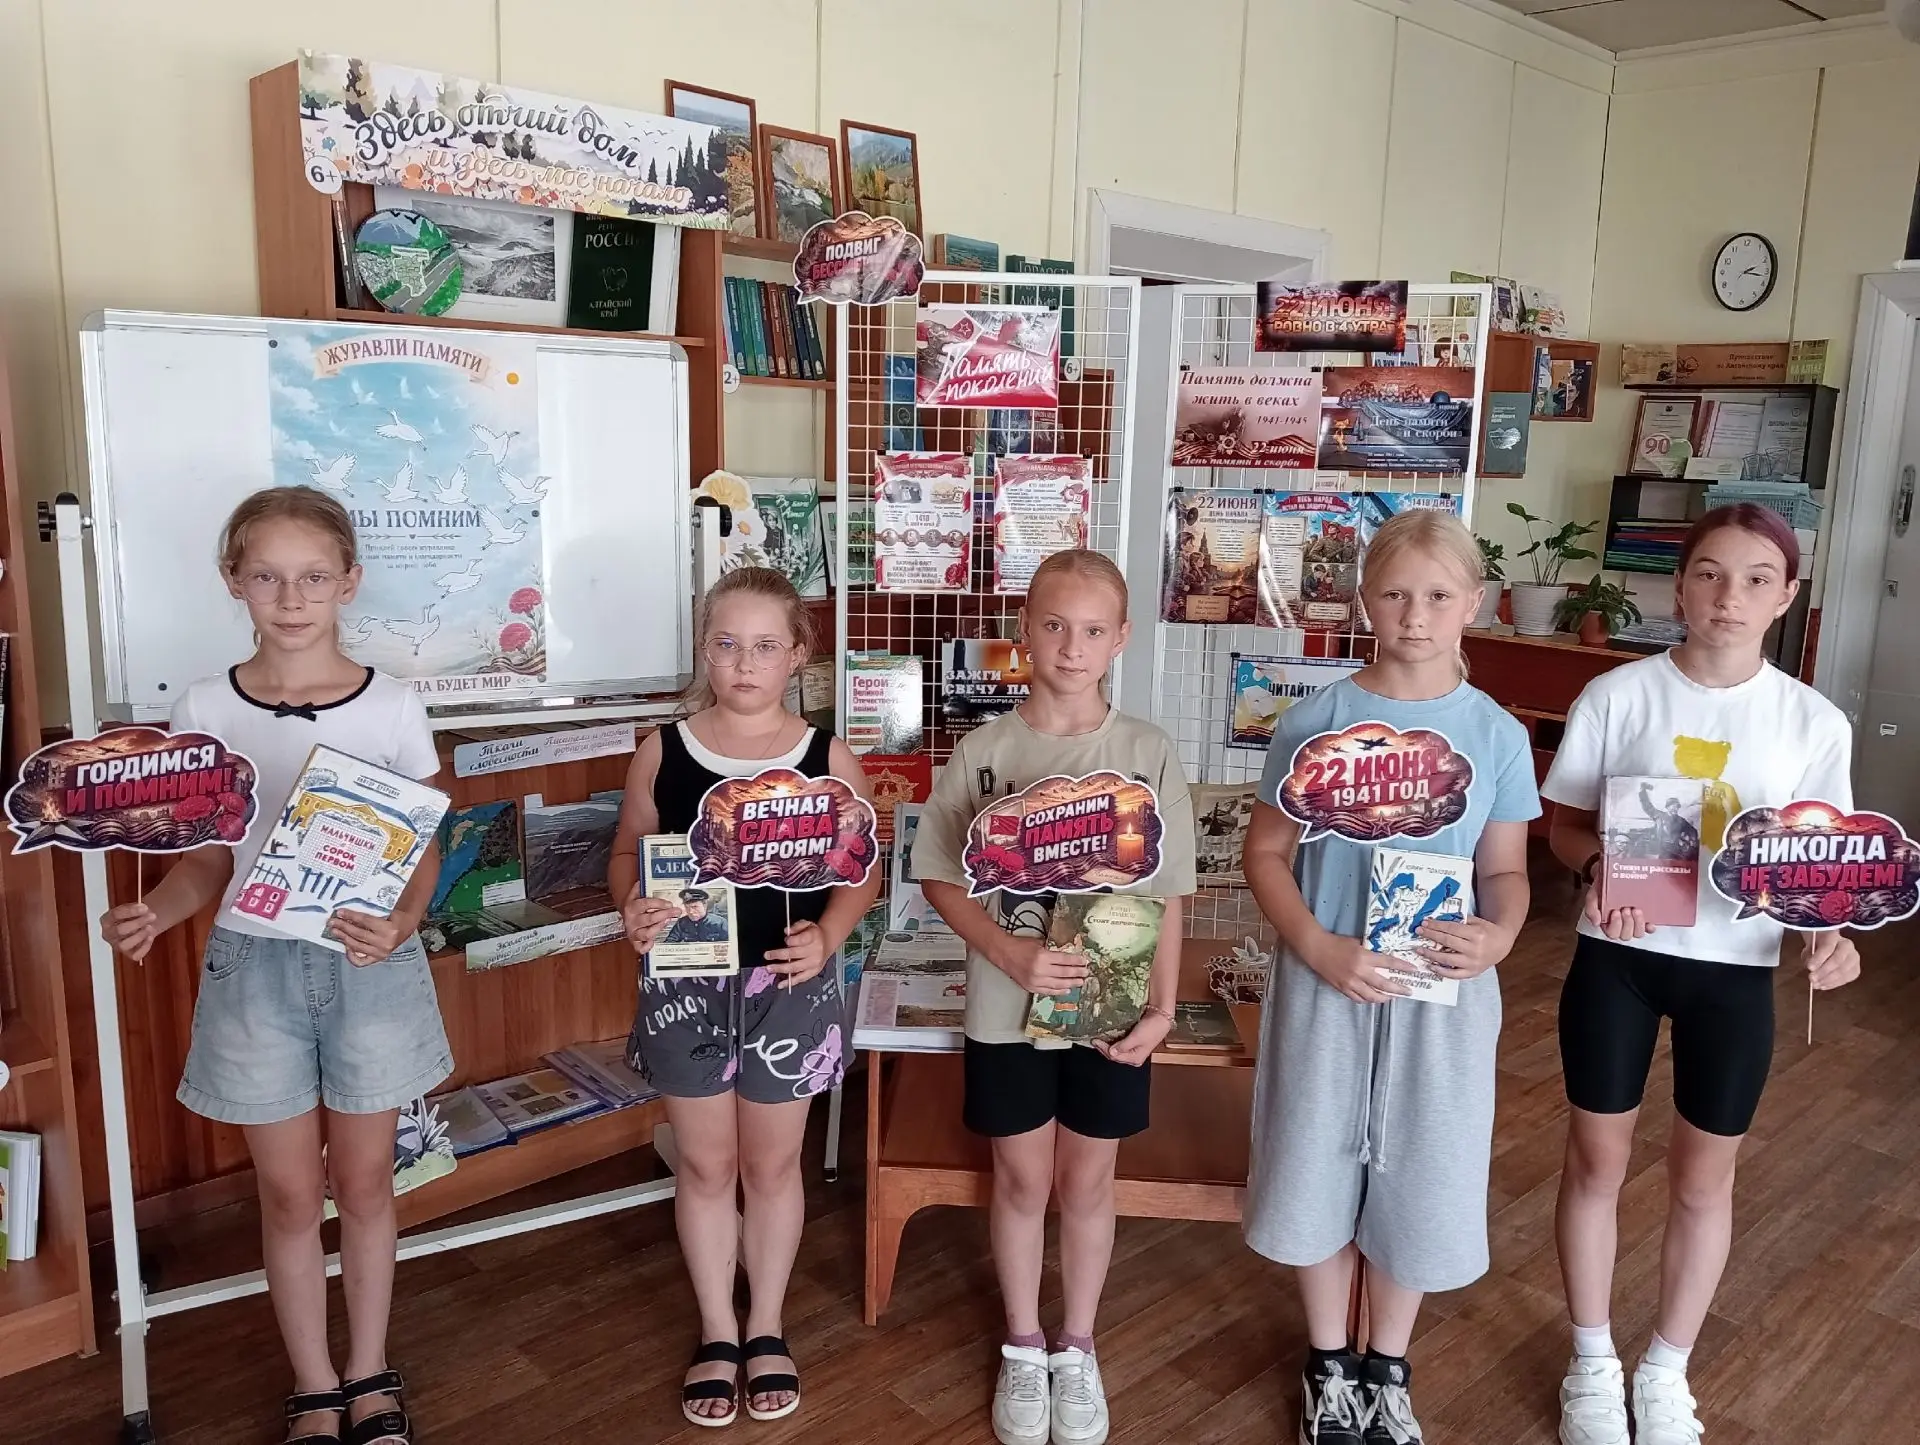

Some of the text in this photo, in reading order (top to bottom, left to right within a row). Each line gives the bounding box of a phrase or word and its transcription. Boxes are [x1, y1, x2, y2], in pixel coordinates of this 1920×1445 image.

[355, 98, 638, 168] Здесь отчий дом
[310, 165, 338, 184] 6+
[428, 144, 690, 201] и здесь моё начало
[825, 237, 882, 262] ПОДВИГ
[1275, 295, 1391, 320] 22 ИЮНЯ
[1274, 320, 1388, 333] РОВНО В 4 УТРА
[324, 338, 483, 373] ЖУРАВЛИ ПАМЯТИ
[939, 342, 1031, 380] Память
[1066, 362, 1079, 374] 6+
[944, 361, 1055, 402] поколений
[1180, 371, 1313, 387] Память должна
[1192, 395, 1300, 406] жить в веках
[1256, 415, 1308, 425] 1941-1945
[1369, 415, 1448, 427] День памяти
[1403, 428, 1458, 441] и скорби
[1251, 441, 1305, 455] 22 июня
[1645, 437, 1671, 455] 90
[1181, 455, 1300, 468] День памяти и скорби
[1197, 496, 1257, 509] 22 ИЮНЯ
[386, 510, 481, 528] ПОМНИМ
[437, 678, 478, 691] БУДЕТ
[482, 675, 511, 688] МИР
[853, 676, 888, 690] Герои
[946, 670, 1001, 681] ЗАЖГИ
[853, 689, 884, 697] Великой
[945, 684, 1032, 695] СВЕЧУ ПА
[478, 740, 524, 758] Ткачи
[76, 743, 217, 787] ГОРДИМСЯ
[469, 747, 539, 771] словесности
[1304, 749, 1440, 792] 22 ИЮНЯ
[66, 766, 233, 815] И ПОМНИМ!
[1331, 778, 1431, 808] 1941 ГОД
[742, 793, 829, 820] ВЕЧНАЯ
[1025, 795, 1110, 828] СОХРАНИМ
[320, 825, 376, 850] МАЛЬЧИШКИ
[738, 814, 833, 845] СЛАВА
[1024, 813, 1115, 849] ПАМЯТЬ
[323, 844, 357, 862] СОРОК
[741, 836, 832, 865] ГЕРОЯМ!
[1033, 835, 1107, 865] ВМЕСТЕ!
[1750, 835, 1887, 865] НИКОГДА
[314, 851, 355, 871] ПЕРВОМ
[653, 861, 698, 874] АЛЕК
[1612, 862, 1640, 873] Стихи
[1649, 865, 1691, 874] рассказы
[1619, 872, 1649, 880] войне
[1741, 863, 1904, 891] НЕ ЗАБУДЕМ!
[495, 930, 539, 951] Экология
[1237, 972, 1268, 983] ПАСИБ
